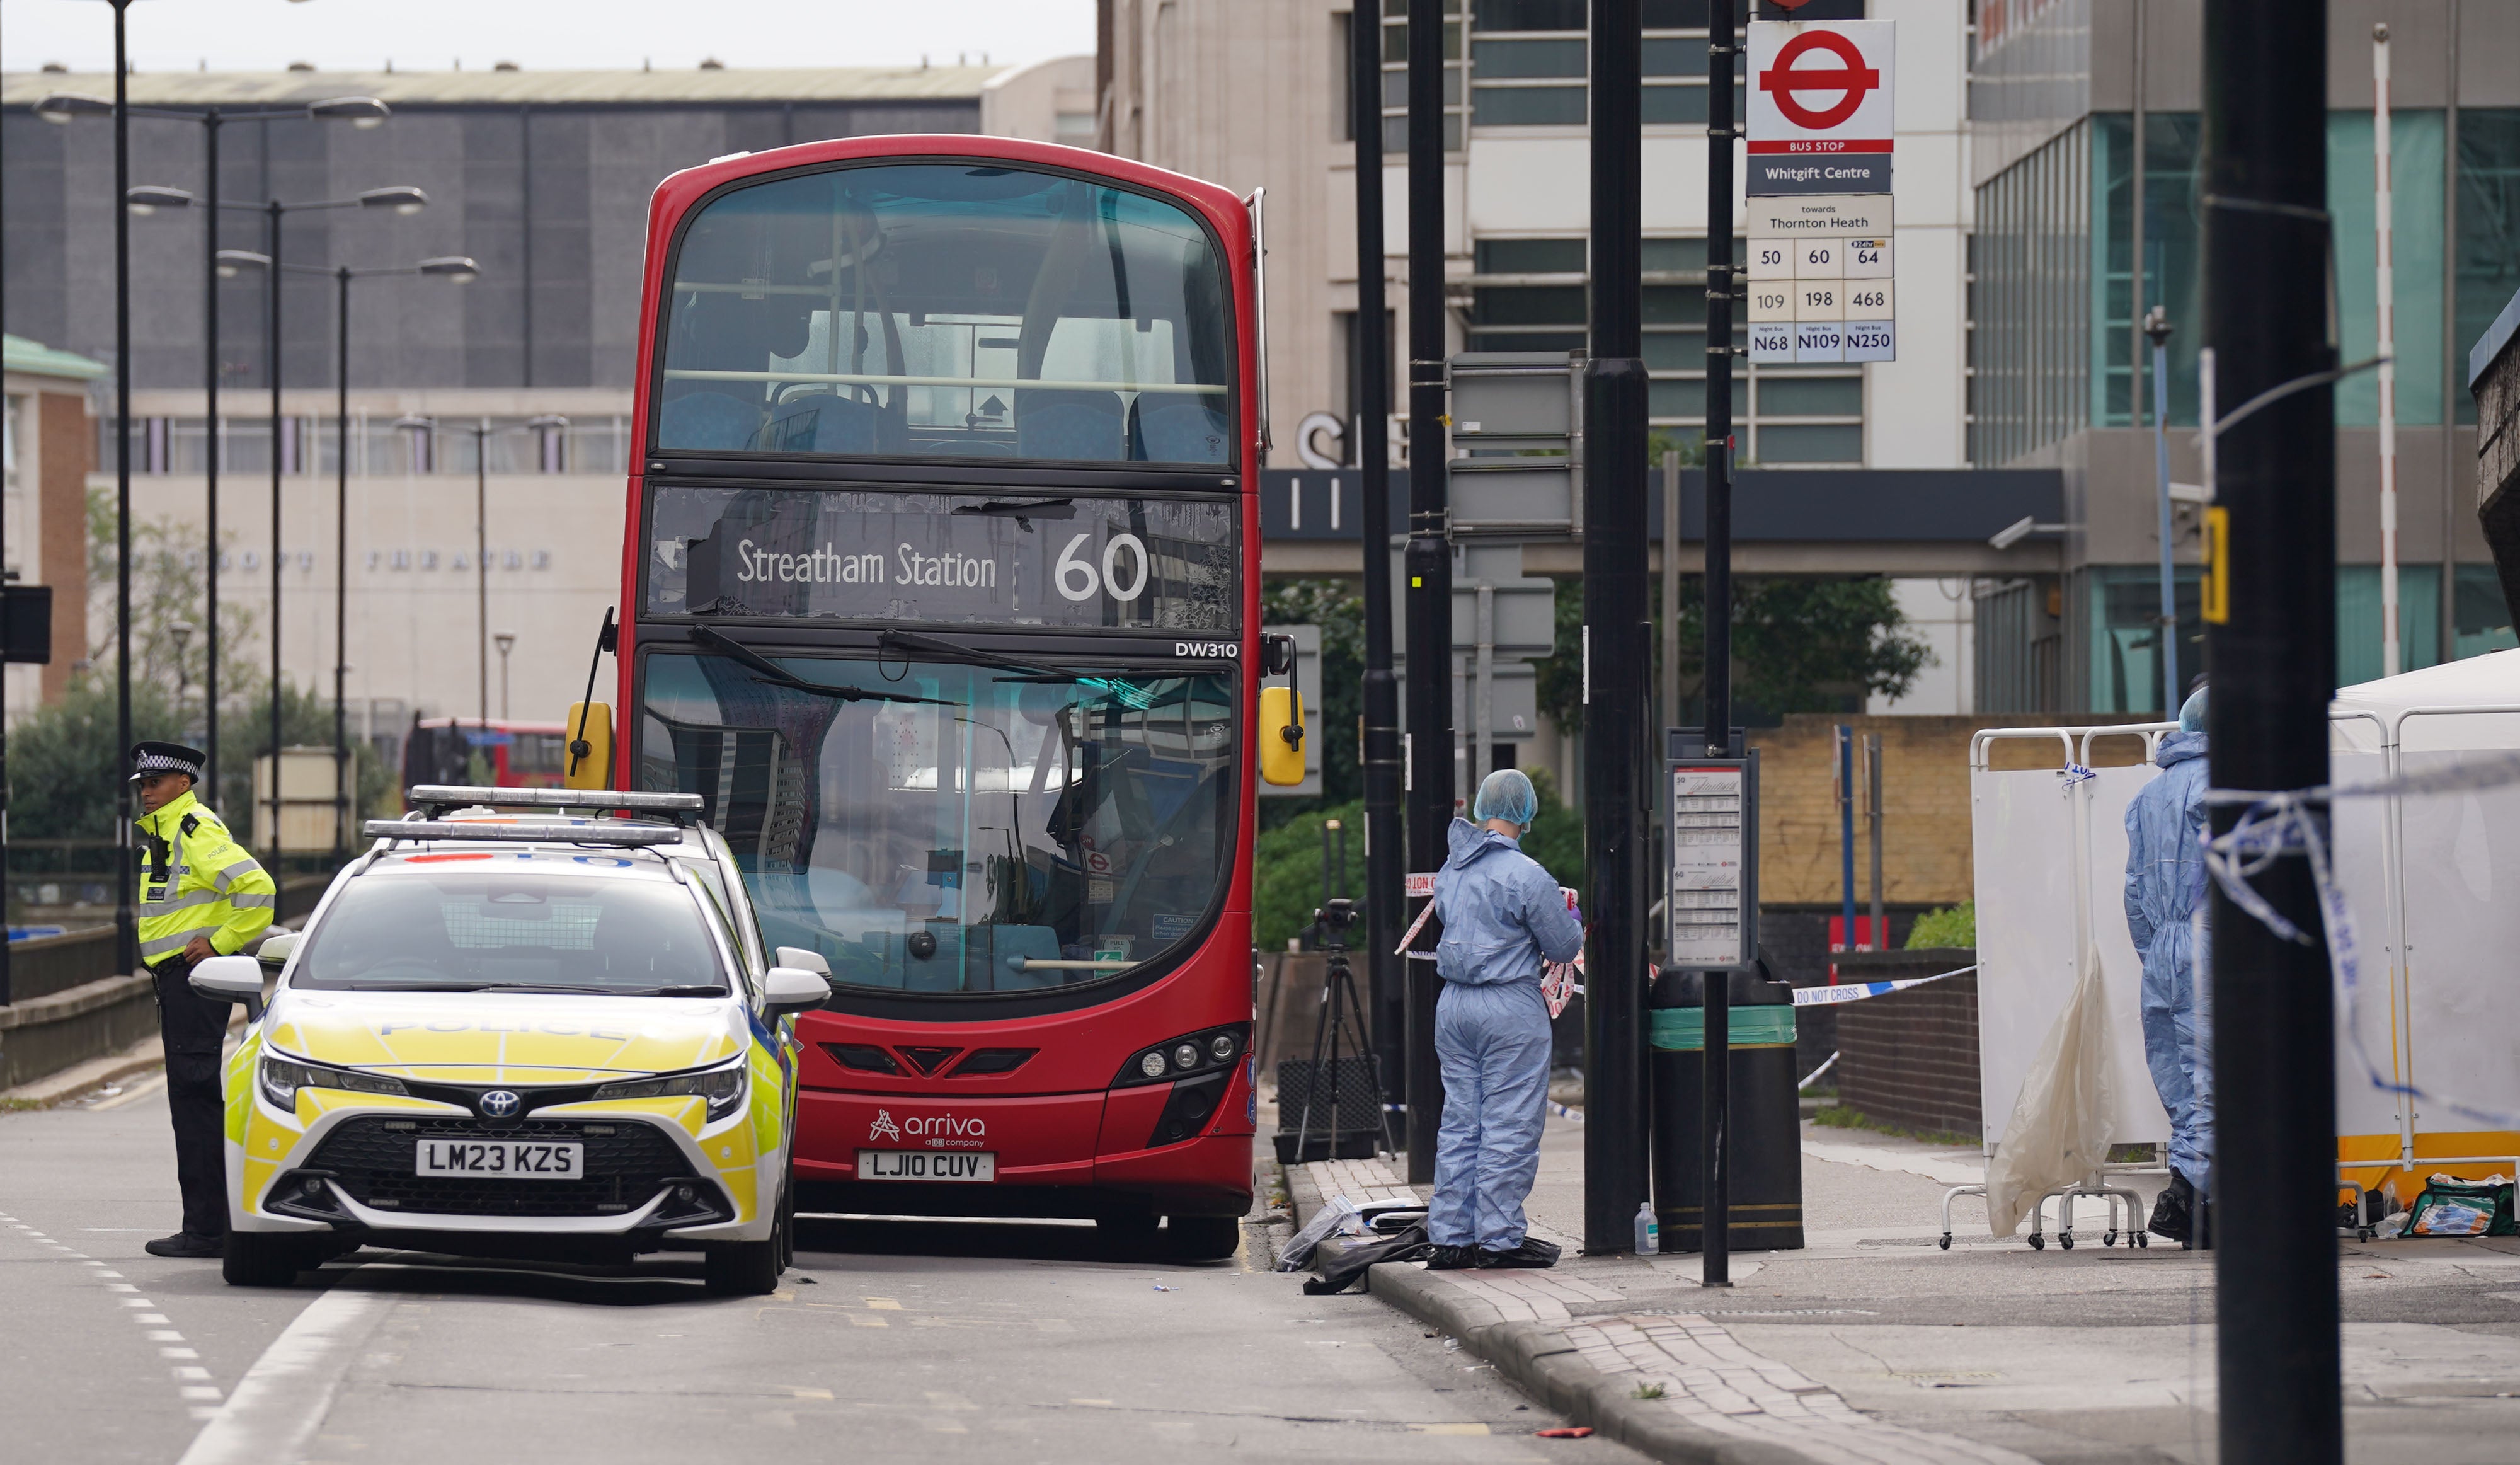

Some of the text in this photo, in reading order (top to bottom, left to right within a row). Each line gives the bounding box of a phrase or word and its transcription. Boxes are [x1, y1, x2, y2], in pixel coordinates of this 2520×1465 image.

[1790, 142, 1845, 151] BUS STOP
[1765, 167, 1870, 181] Whitgift Centre
[1770, 217, 1869, 229] Thornton Heath
[1761, 251, 1781, 264] 50
[1809, 250, 1830, 264] 60
[1858, 250, 1878, 263] 64
[1758, 295, 1784, 309] 109
[1806, 292, 1833, 306] 198
[1853, 292, 1884, 306] 468
[1755, 336, 1788, 350] N68
[1799, 335, 1840, 348] N109
[1847, 334, 1890, 347] N250
[738, 539, 995, 587] Streatham Station
[1055, 533, 1148, 602] 60
[1176, 643, 1238, 657] DW310
[207, 844, 229, 860] POLICE
[1797, 987, 1858, 1004] DO NOT CROSS
[381, 1020, 626, 1041] POLICE
[905, 1113, 985, 1136] arriva
[933, 1139, 944, 1147] DB
[429, 1144, 572, 1172] LM23 KZS
[873, 1154, 979, 1177] LJ10 CUV
